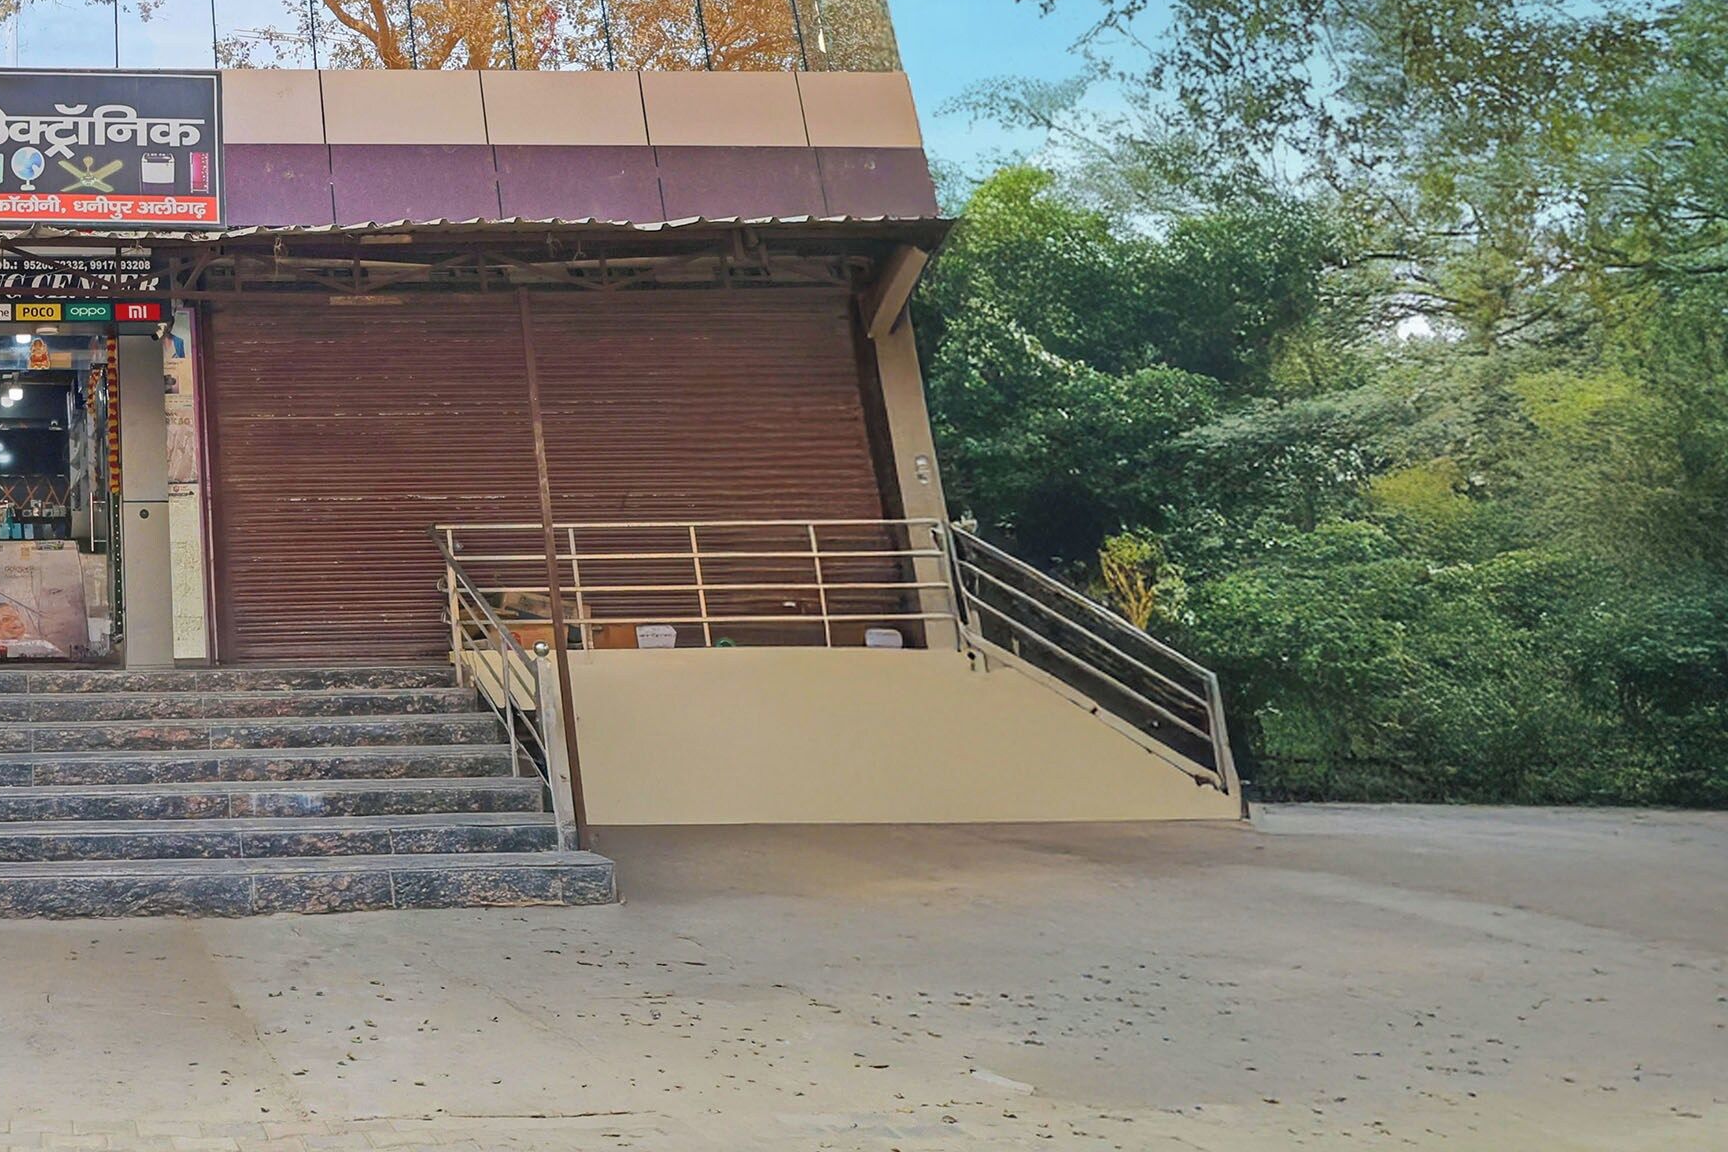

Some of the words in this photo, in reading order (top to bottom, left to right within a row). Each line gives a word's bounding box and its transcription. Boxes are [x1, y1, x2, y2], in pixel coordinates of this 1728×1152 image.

[73, 195, 132, 220] धनीपुर
[136, 196, 207, 220] अलीगढ़
[22, 307, 54, 317] POCO
[70, 307, 106, 316] oppo
